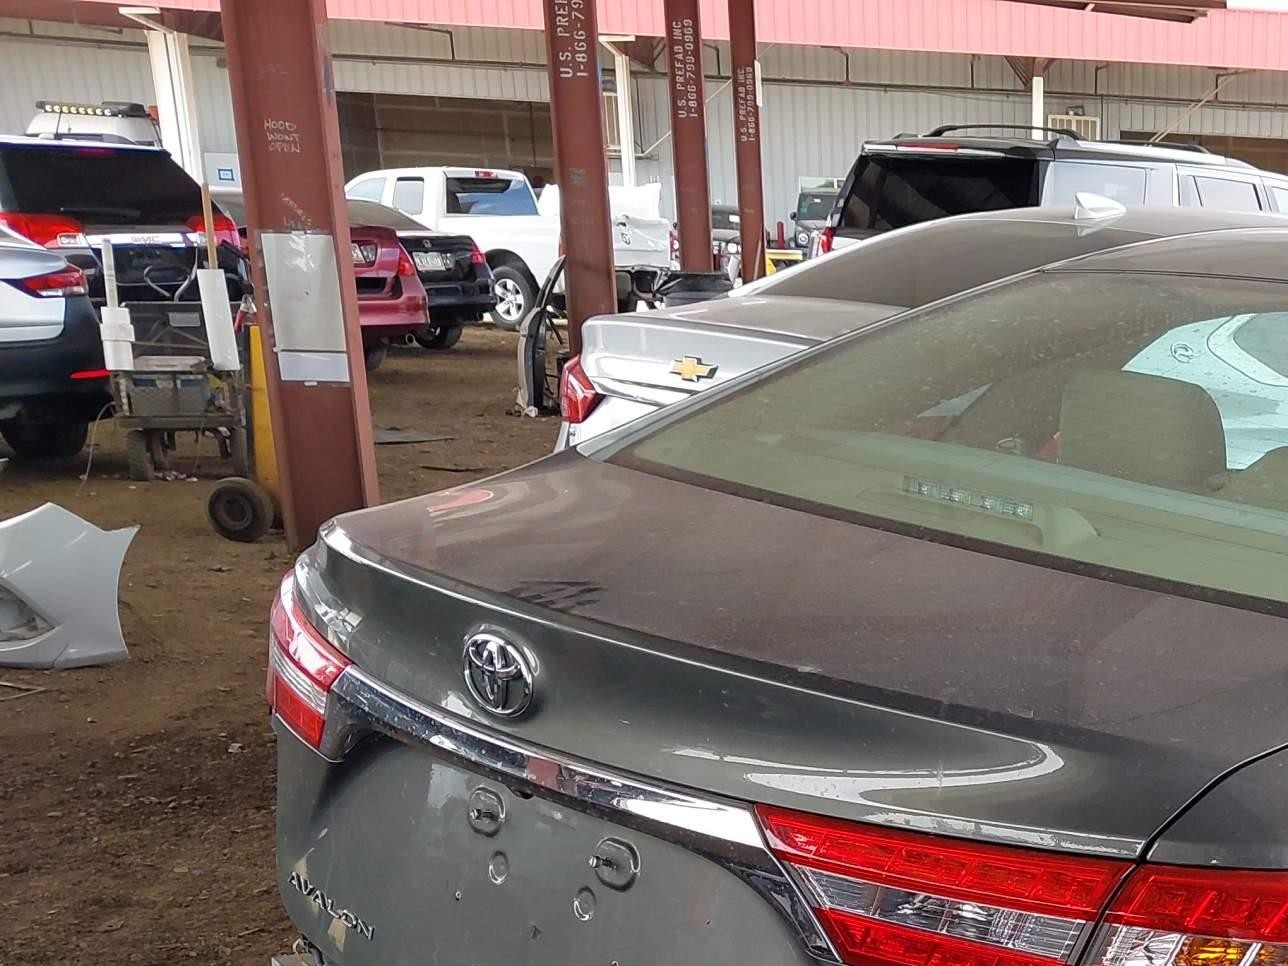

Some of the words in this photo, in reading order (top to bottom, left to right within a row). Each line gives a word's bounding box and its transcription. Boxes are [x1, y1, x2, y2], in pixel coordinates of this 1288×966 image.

[559, 46, 573, 78] U.S.
[677, 96, 688, 118] U.S.
[263, 118, 297, 131] HOOD
[740, 123, 748, 142] U.S.
[266, 131, 300, 142] WONT
[287, 871, 375, 941] AVALON
